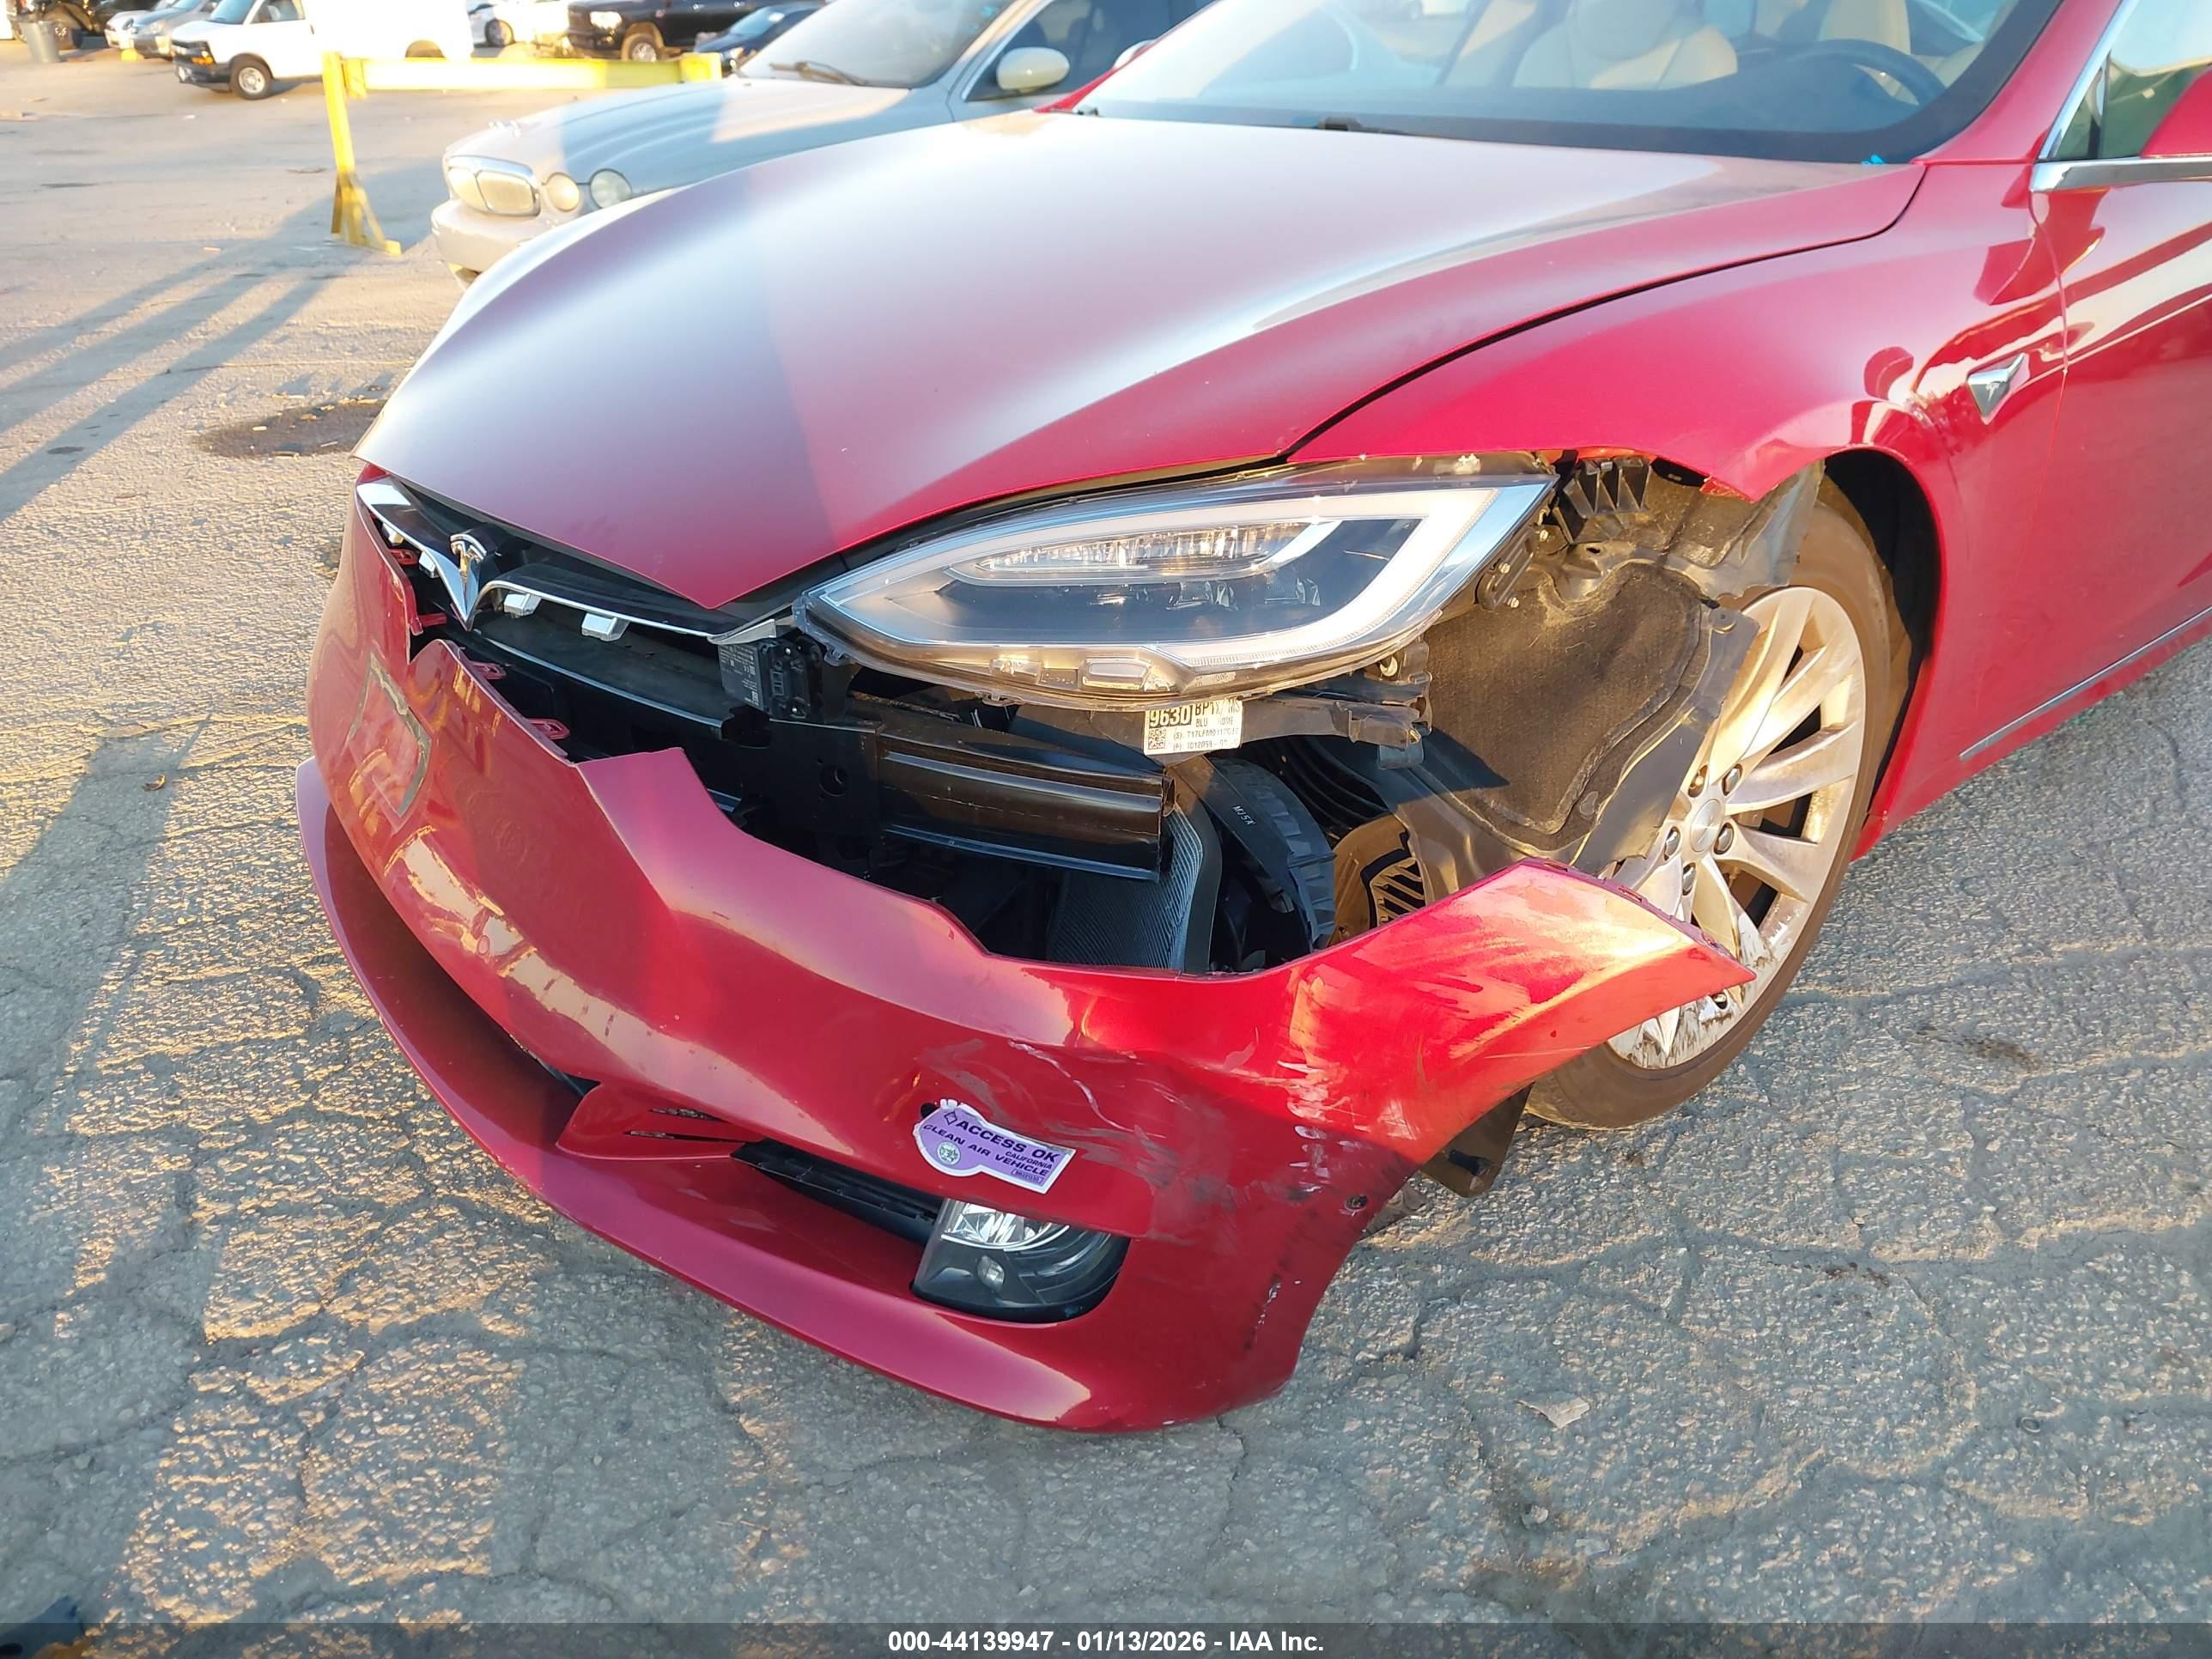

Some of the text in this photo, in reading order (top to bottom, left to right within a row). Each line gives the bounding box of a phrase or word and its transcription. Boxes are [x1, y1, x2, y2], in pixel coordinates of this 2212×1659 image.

[1150, 704, 1191, 728] 9630
[923, 1124, 1050, 1176] CLEAN AIR VEHICLE
[956, 1120, 1061, 1163] ACCESS OK
[1005, 1151, 1053, 1170] CALIFORNIA
